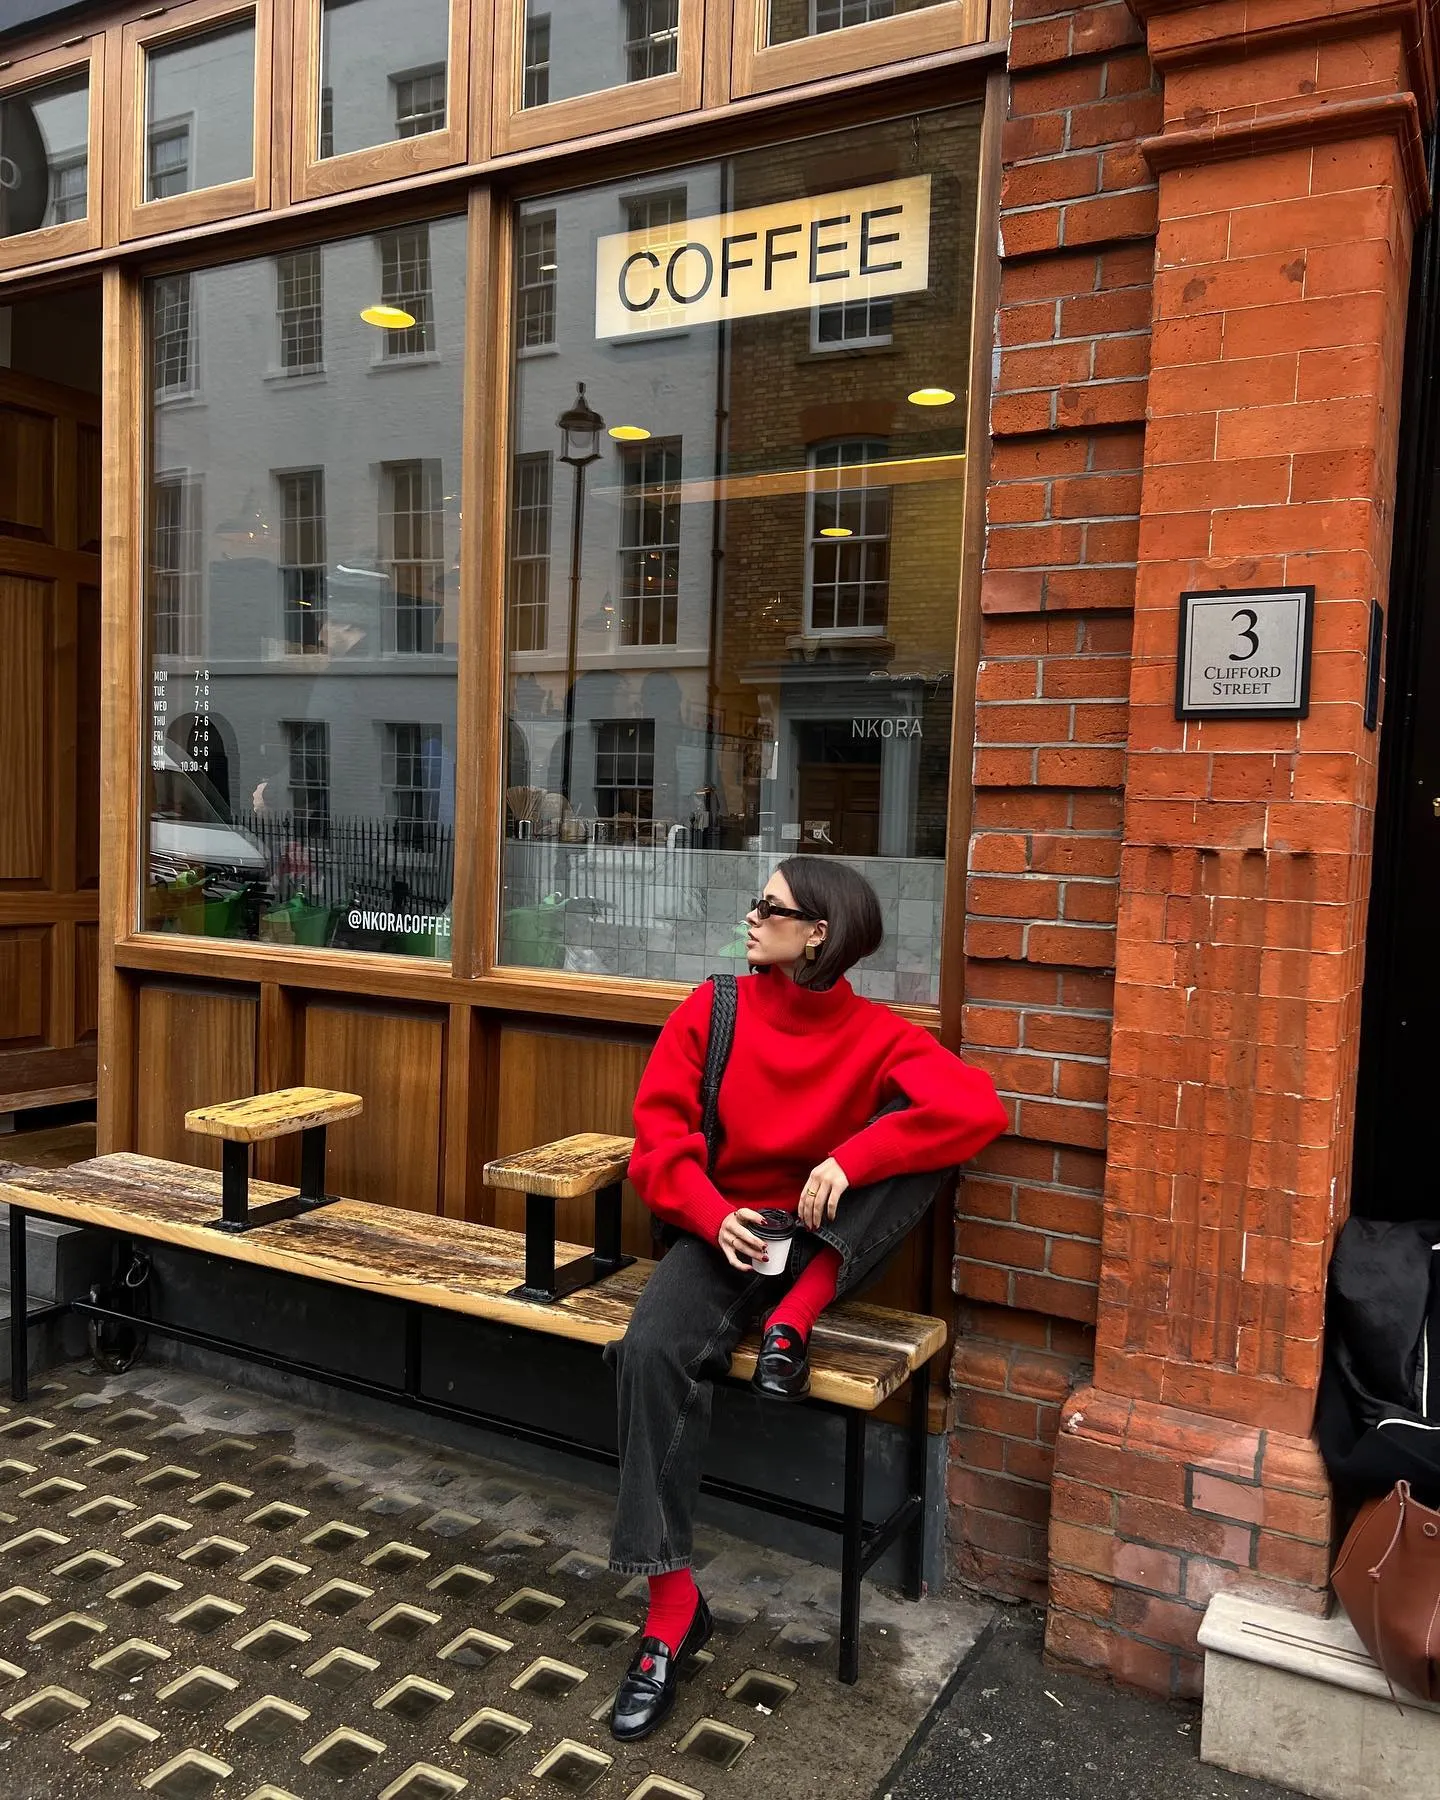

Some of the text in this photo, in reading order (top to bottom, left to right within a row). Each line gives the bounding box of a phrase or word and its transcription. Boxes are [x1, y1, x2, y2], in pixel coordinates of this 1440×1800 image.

[618, 204, 903, 312] COFFEE
[1228, 609, 1259, 661] 3
[153, 671, 168, 682] MON
[1204, 666, 1281, 680] CLIFFORD
[153, 686, 165, 696] TUE
[1212, 682, 1271, 696] STREET
[153, 701, 167, 711] WED
[153, 716, 166, 726] THU
[852, 718, 924, 738] NKORA
[153, 731, 164, 741] FRI
[153, 746, 164, 756] SAT
[153, 761, 165, 771] SUN
[348, 909, 451, 937] @NKORACOFFEE
